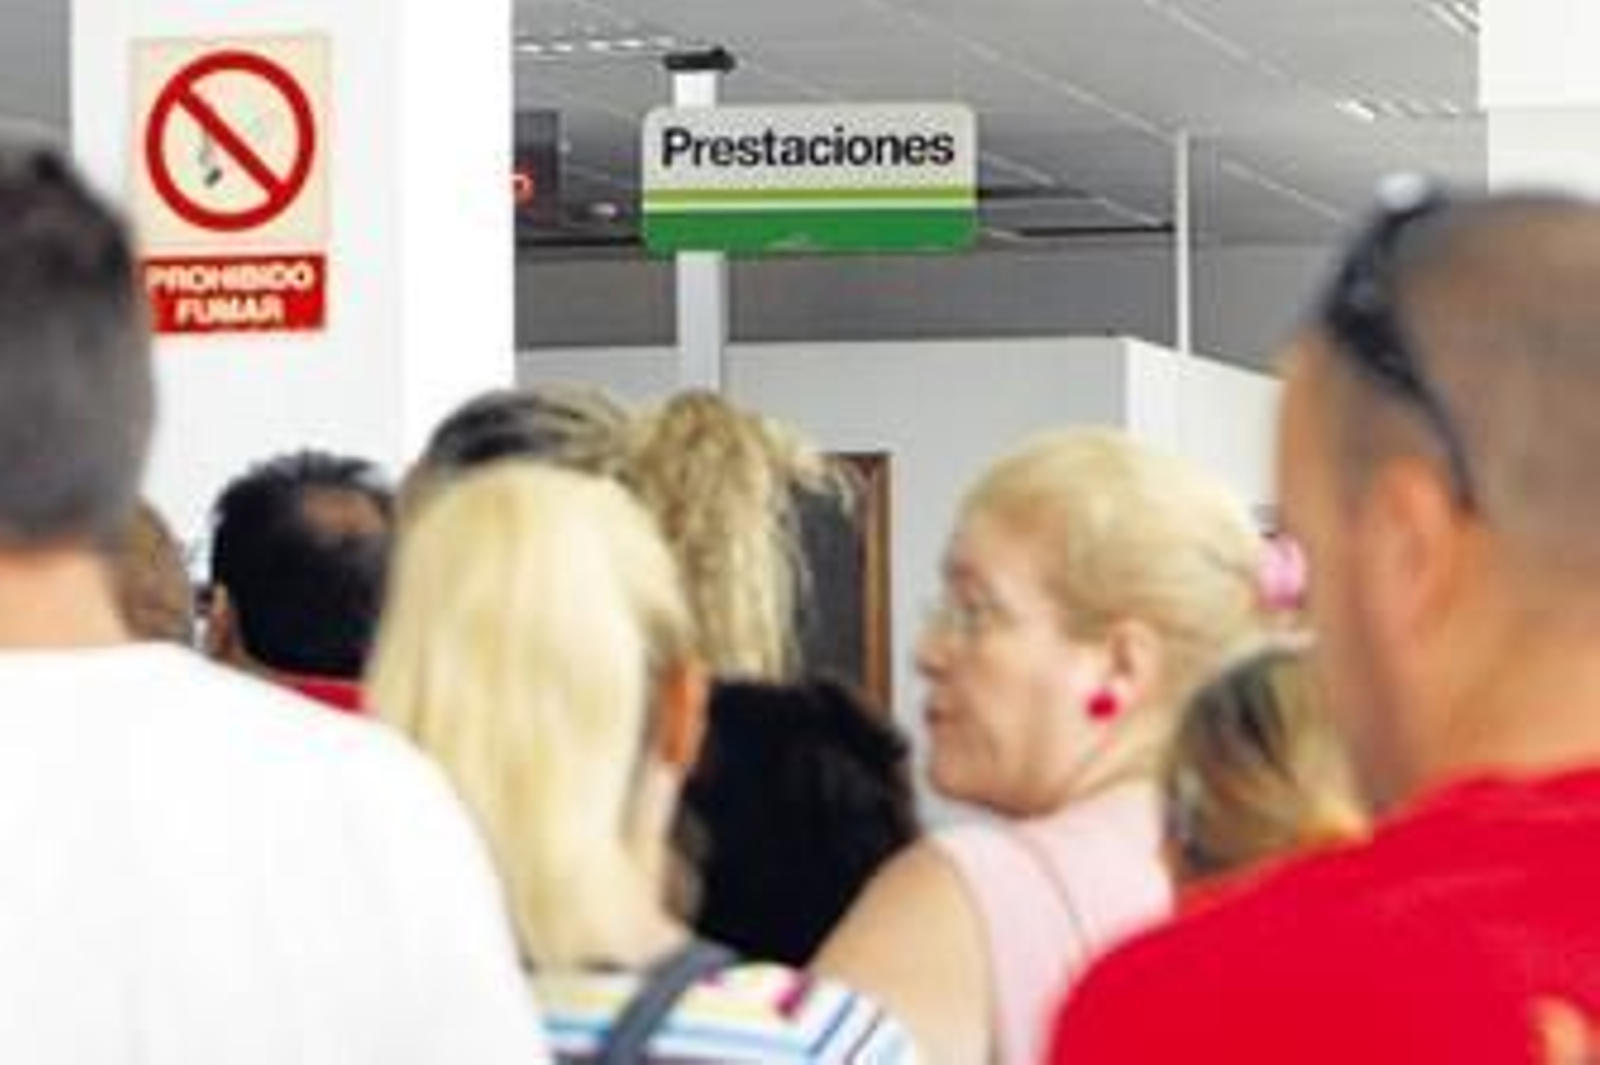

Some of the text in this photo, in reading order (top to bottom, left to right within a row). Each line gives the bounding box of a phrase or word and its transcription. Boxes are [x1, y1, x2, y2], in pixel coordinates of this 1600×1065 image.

[661, 126, 956, 167] Prestaciones
[146, 262, 315, 294] PROHIBIDO
[174, 296, 285, 325] FUMAR
